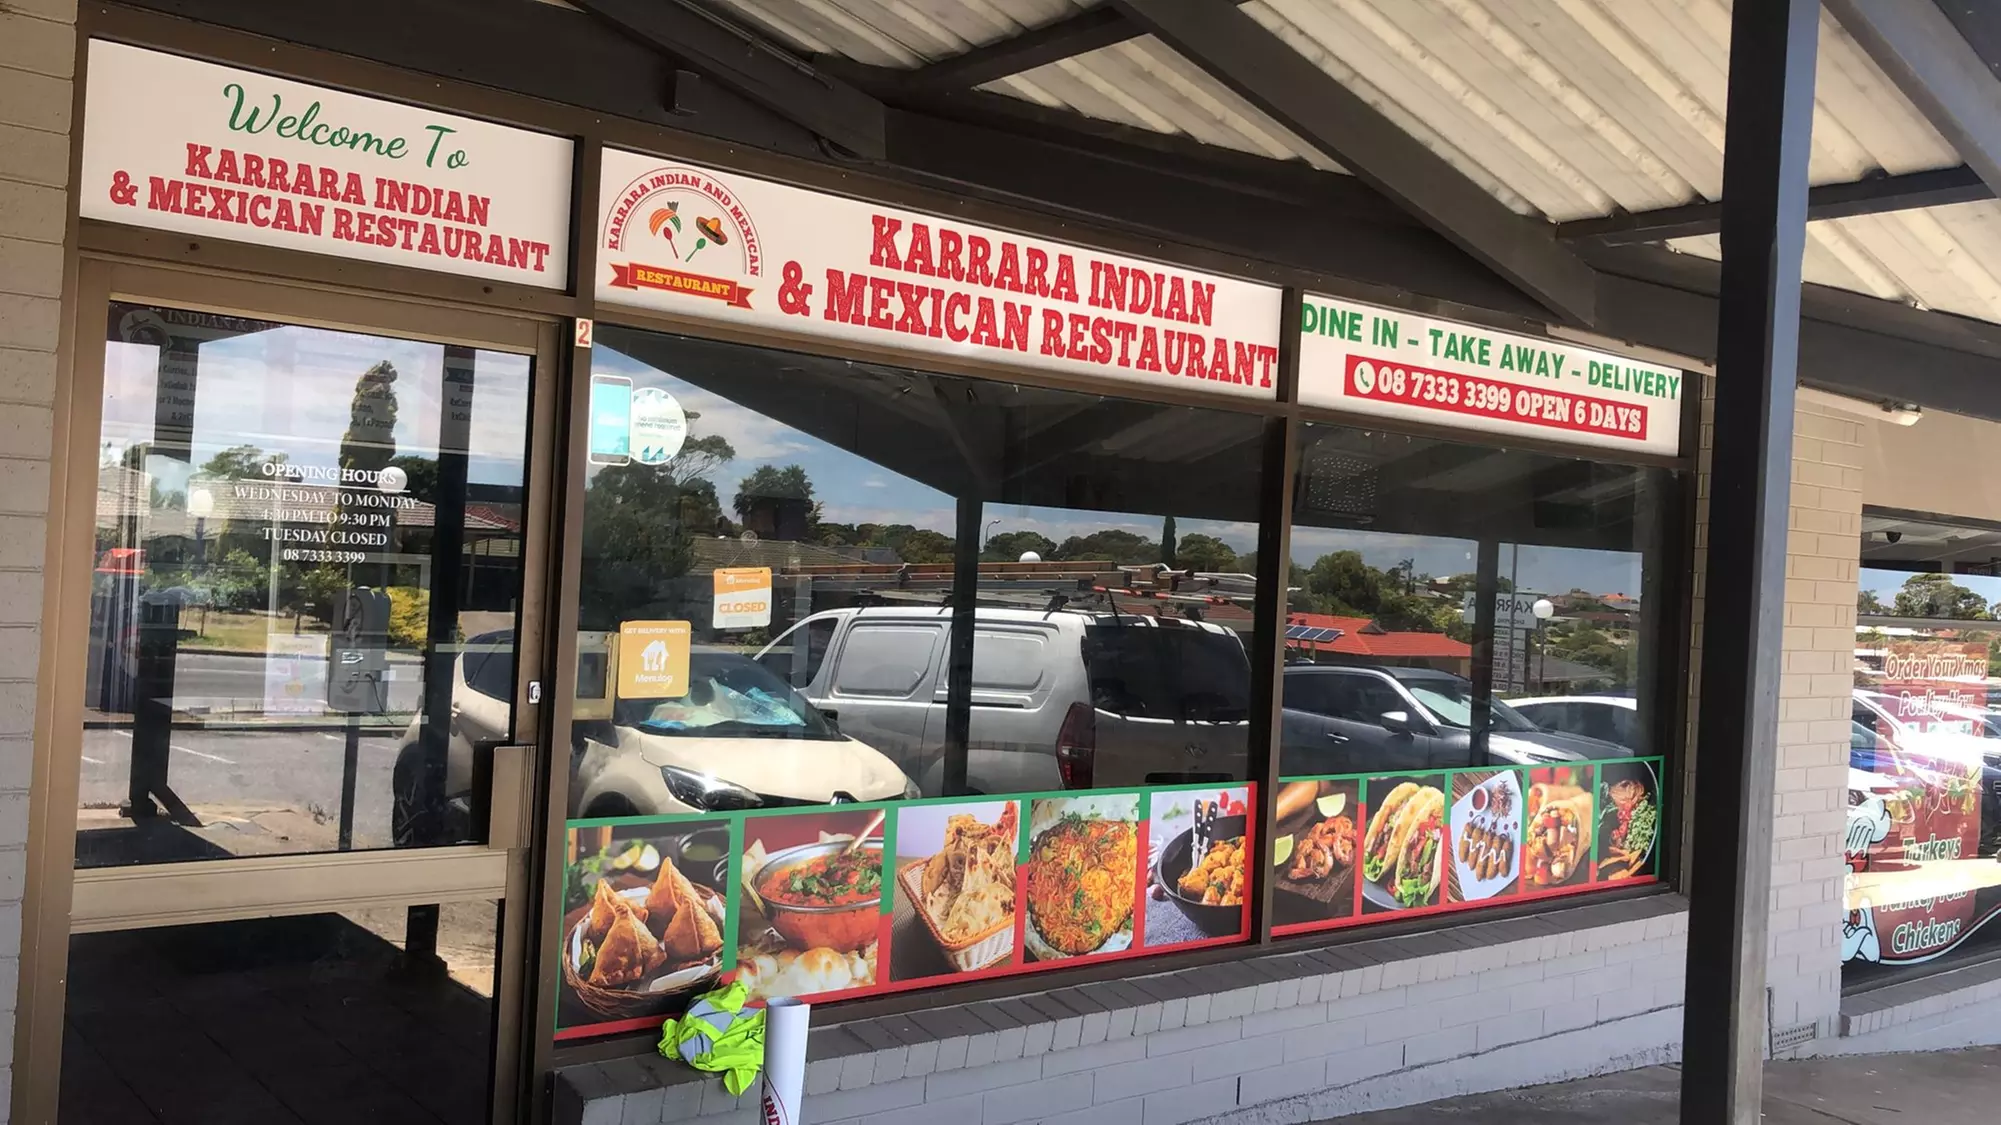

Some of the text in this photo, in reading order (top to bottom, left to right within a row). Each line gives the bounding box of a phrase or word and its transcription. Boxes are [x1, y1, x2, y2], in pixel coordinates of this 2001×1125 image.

[223, 83, 469, 169] Welcome To
[185, 142, 491, 227] KARRARA INDIAN
[109, 170, 550, 273] & MEXICAN RESTAURANT
[608, 173, 760, 277] KARRARA INDIAN AND MEXICAN
[636, 269, 731, 296] RESTAURANT
[869, 214, 1216, 327] KARRARA INDIAN
[167, 310, 231, 328] INDIAN
[777, 260, 1278, 388] & MEXICAN RESTAURANT
[578, 321, 590, 345] 2
[1301, 303, 1363, 342] DINE
[1372, 317, 1398, 349] IN
[1429, 329, 1491, 366] TAKE
[1499, 344, 1565, 379] AWAY
[1588, 360, 1681, 400] DELIVERY
[1377, 367, 1642, 434] 08 7333 3399 OPEN 6 DAYS
[262, 463, 397, 485] OPENING HOURS
[234, 486, 417, 509] WEDNESDAY TO MONDAY
[261, 509, 391, 527] 4:30 PM TO 9:30 PM
[262, 527, 388, 546] TUESDAY CLOSED
[283, 548, 366, 564] 08 7333 3399
[719, 601, 767, 614] CLOSED
[635, 673, 673, 686] Menulog
[1885, 653, 1987, 680] Order Your Xmas
[1902, 833, 1962, 866] Turkeys
[1892, 918, 1961, 954] Chickens
